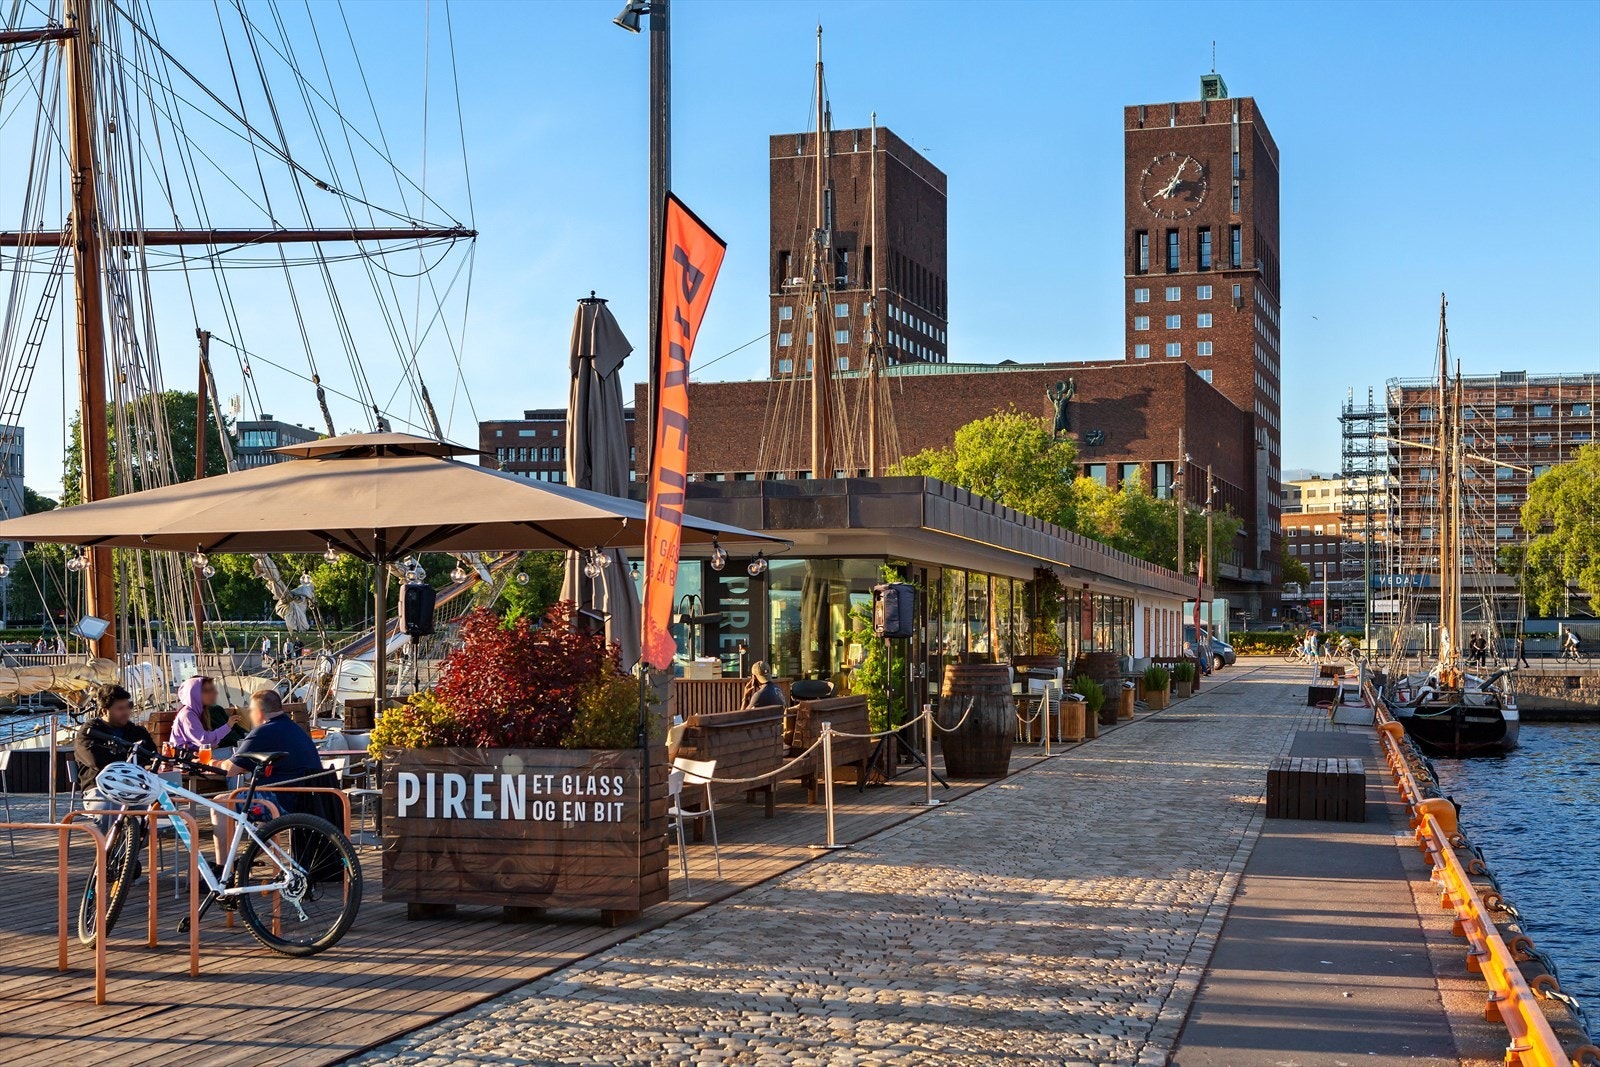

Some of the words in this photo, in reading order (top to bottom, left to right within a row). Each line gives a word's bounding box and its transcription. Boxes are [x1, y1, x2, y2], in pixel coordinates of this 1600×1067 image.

[655, 243, 705, 527] PIREN
[397, 772, 527, 820] PIREN
[532, 774, 555, 795] ET
[562, 775, 624, 797] GLASS
[532, 800, 556, 822] OG
[562, 801, 586, 822] EN
[594, 802, 625, 823] BIT
